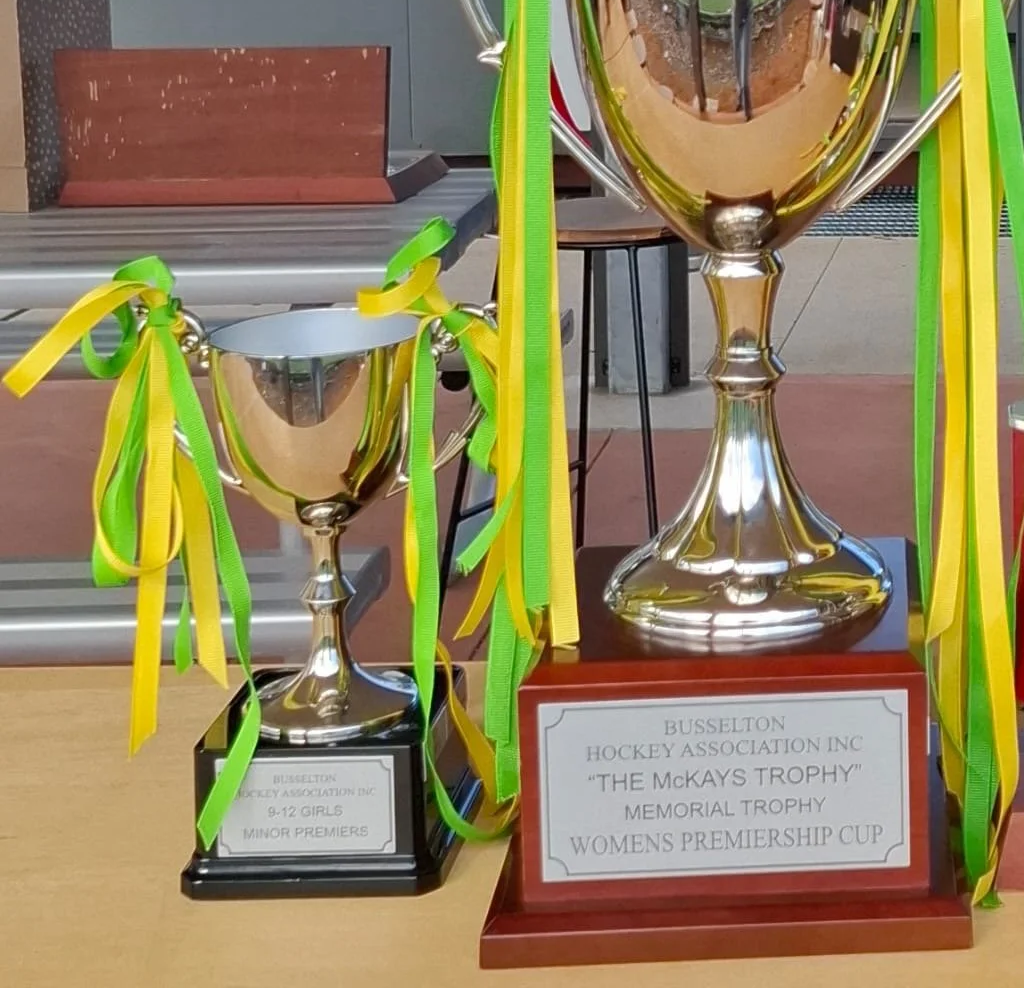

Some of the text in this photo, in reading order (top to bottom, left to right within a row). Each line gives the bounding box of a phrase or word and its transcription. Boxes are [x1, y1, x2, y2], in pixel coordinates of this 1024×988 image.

[663, 716, 786, 735] BUSSELTON
[585, 736, 864, 762] HOCKEY ASSOCIATION INC
[273, 774, 336, 785] BUSSELTON
[653, 768, 747, 790] McKAYS
[283, 788, 355, 798] ASSOCIATION
[268, 805, 343, 818] 9-12 GIRLS
[625, 796, 826, 821] MEMORIAL TROPHY
[243, 826, 368, 840] MINOR PREMIERS
[570, 824, 883, 857] WOMENS PREMIERSHIP CUP
